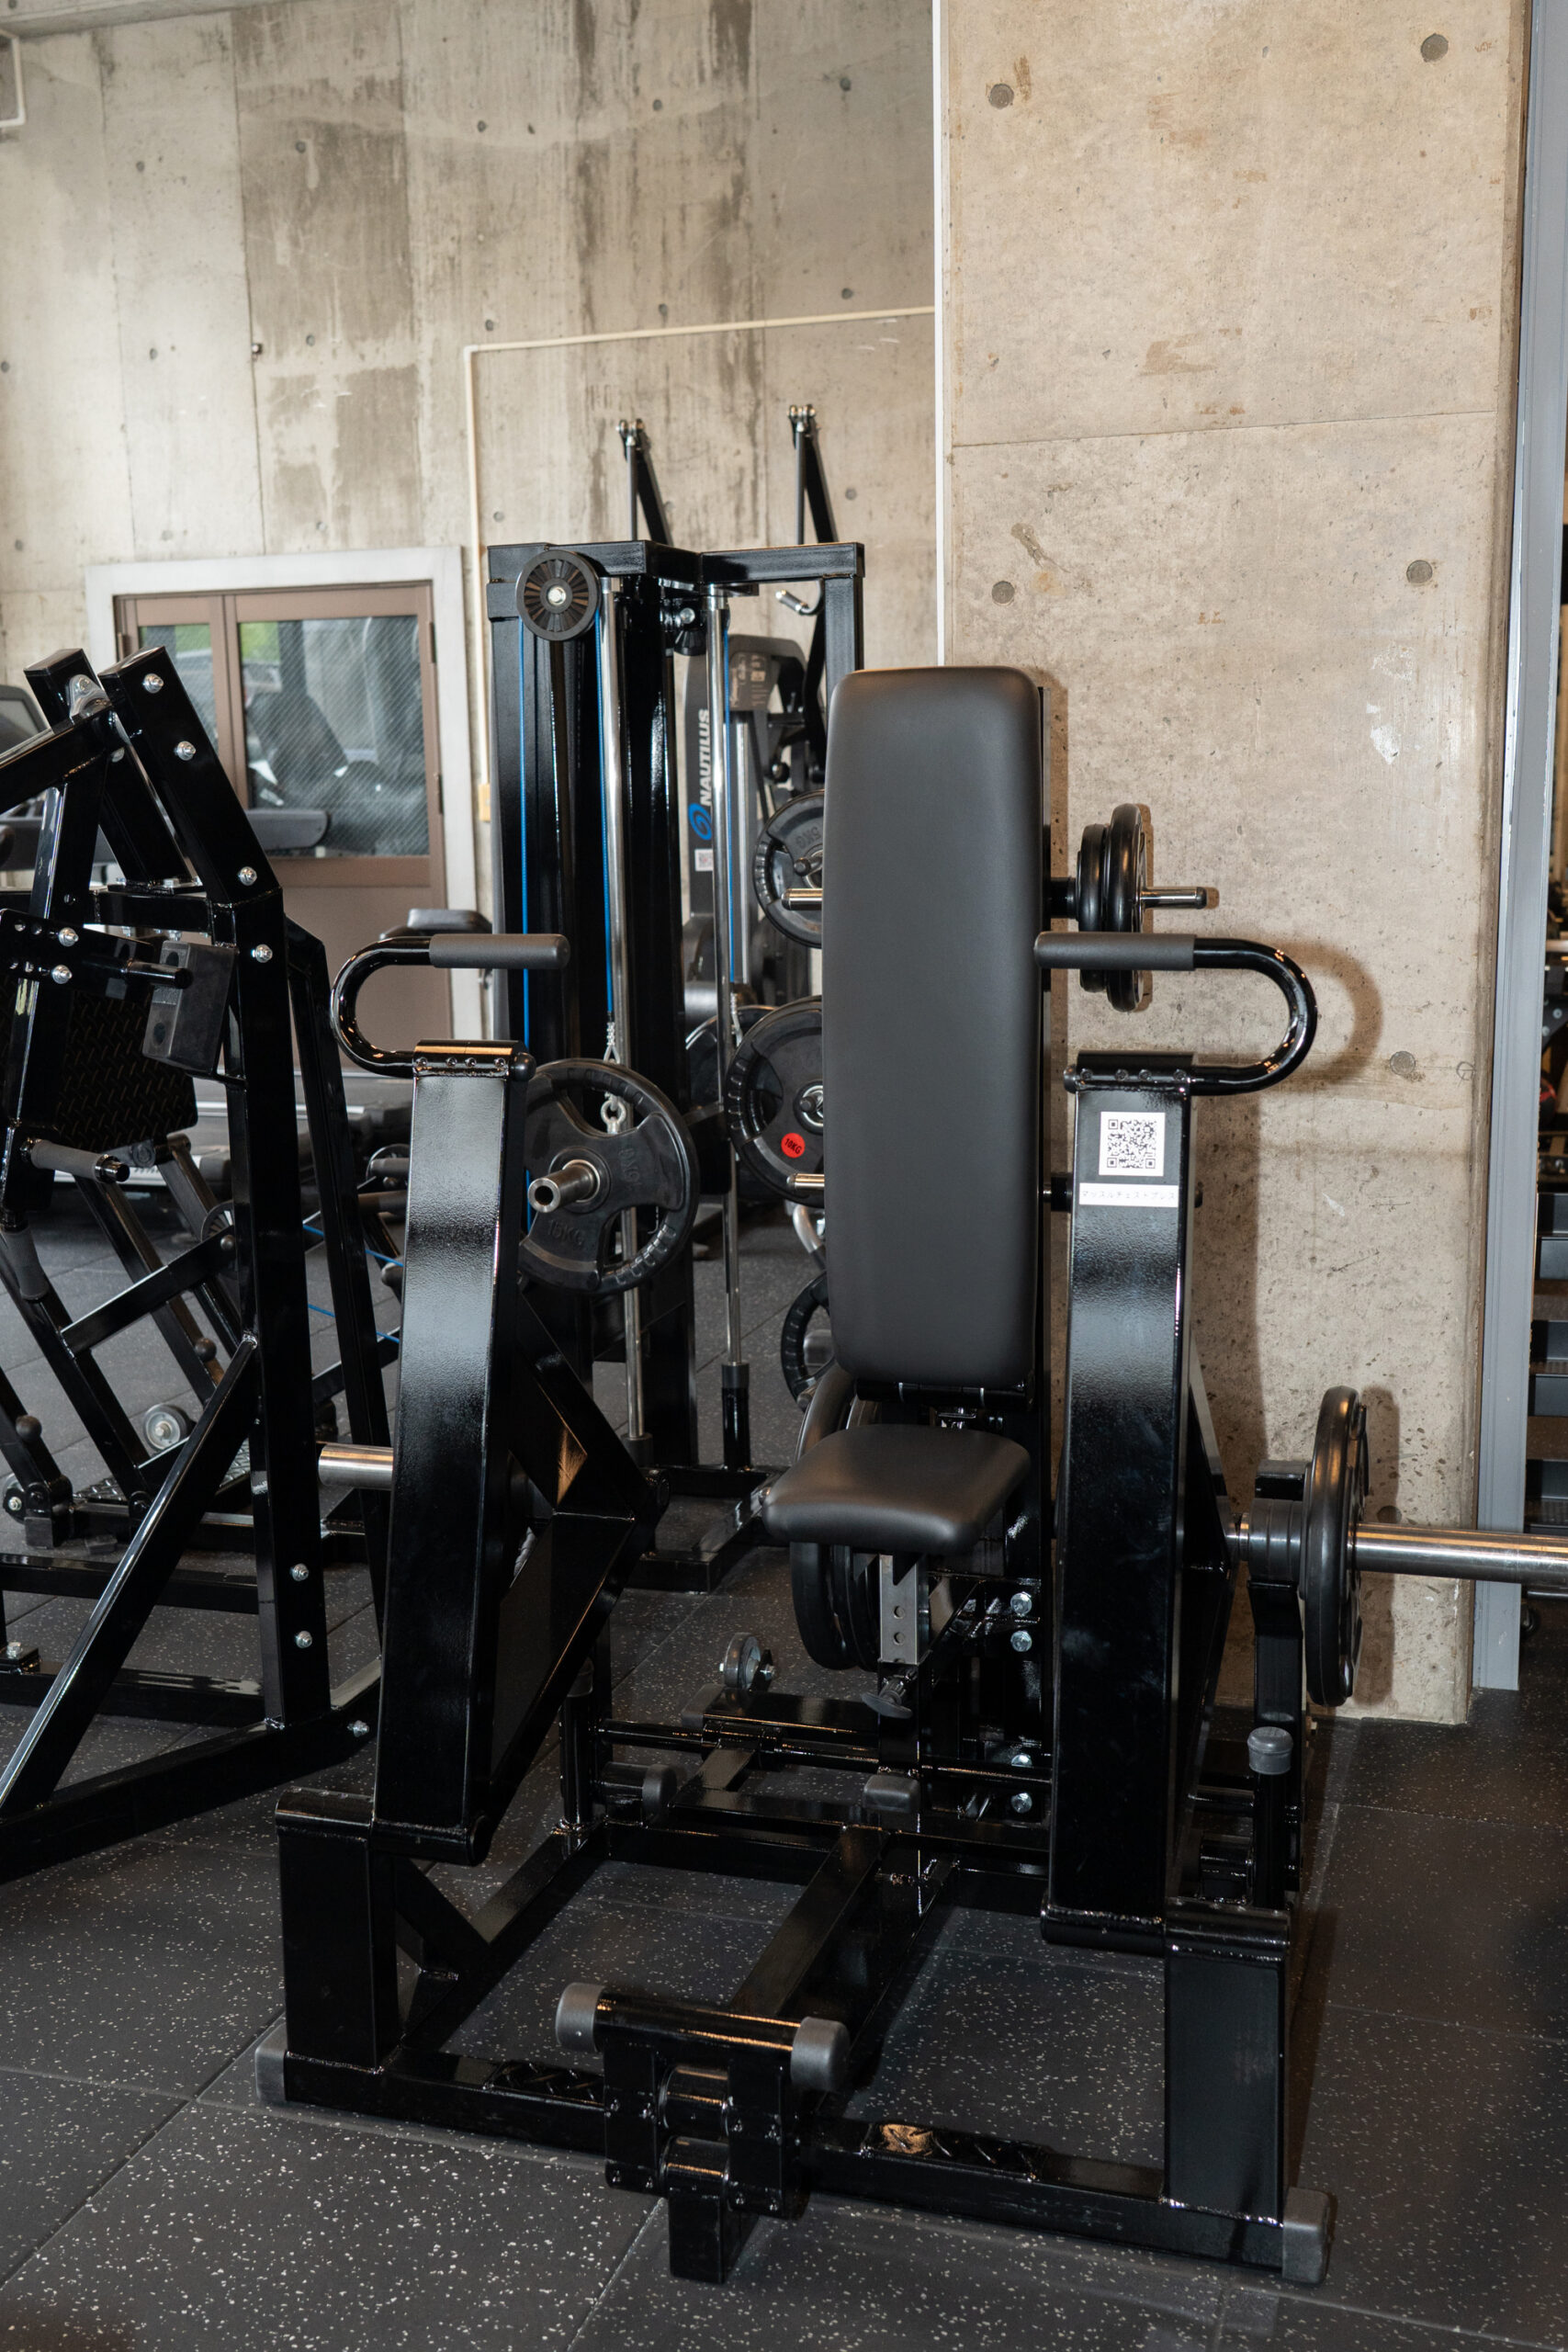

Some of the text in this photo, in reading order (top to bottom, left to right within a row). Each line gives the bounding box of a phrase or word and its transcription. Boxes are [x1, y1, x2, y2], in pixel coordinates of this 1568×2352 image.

[699, 708, 711, 806] NAUTILUS
[796, 827, 820, 848] 5KG
[785, 1138, 801, 1154] 10KG
[547, 1219, 585, 1246] 15KG
